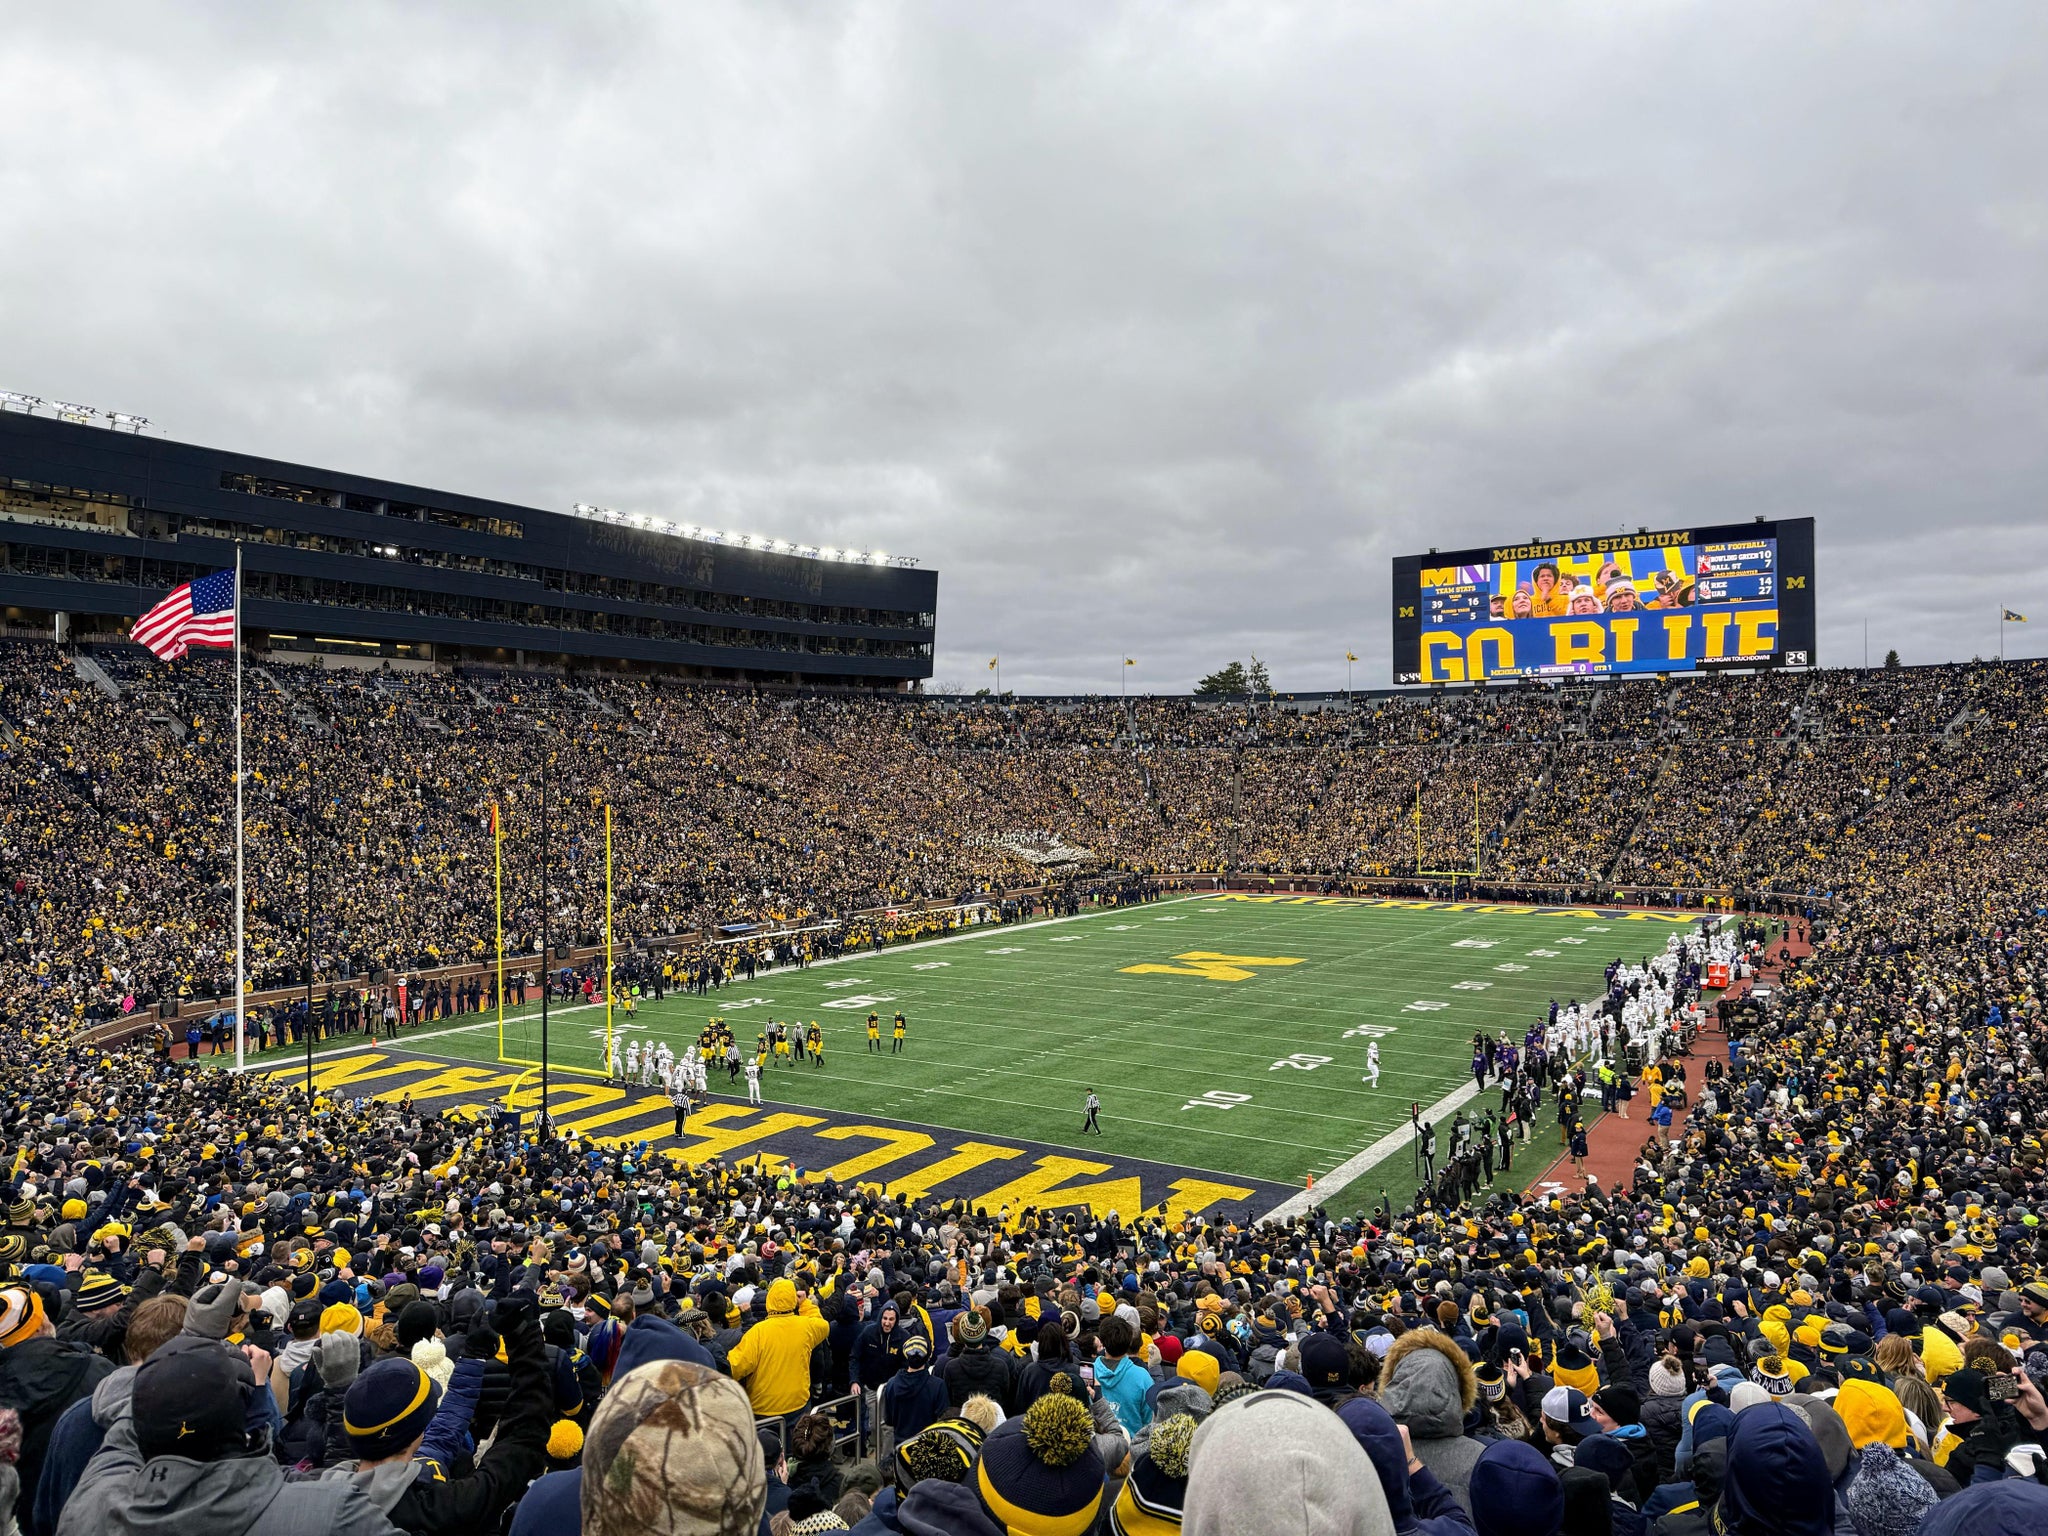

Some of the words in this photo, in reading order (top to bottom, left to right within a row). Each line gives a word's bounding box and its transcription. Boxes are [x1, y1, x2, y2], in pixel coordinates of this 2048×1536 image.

[1493, 541, 1592, 561] MICHIGAN
[1597, 531, 1690, 551] STADIUM
[1727, 541, 1767, 550] FOOTBALL
[1711, 554, 1738, 563] BOWLING
[1738, 552, 1759, 560] GREEN
[1759, 550, 1772, 560] 10
[1731, 562, 1742, 570] ST
[1765, 559, 1772, 568] 7
[1421, 567, 1457, 588] M
[1759, 577, 1772, 586] 14
[1786, 576, 1806, 590] M
[1456, 585, 1476, 593] STATS
[1711, 590, 1727, 598] UAB
[1758, 586, 1772, 595] 27
[1431, 601, 1443, 609] 39
[1468, 597, 1479, 607] 16
[1399, 606, 1414, 618] M
[1432, 615, 1443, 623] 18
[1470, 612, 1476, 620] 5
[1421, 627, 1515, 683] GO
[1787, 653, 1805, 664] 29
[1579, 664, 1586, 672] 0
[1400, 673, 1421, 682] 6:44
[1202, 893, 1707, 923] MICHIGAN
[1114, 951, 1308, 981] M
[1405, 1000, 1451, 1011] 40
[1344, 1023, 1399, 1038] 30
[1271, 1053, 1334, 1071] 20
[1187, 1089, 1252, 1110] 10
[258, 1052, 1258, 1224] MICHIGAN
